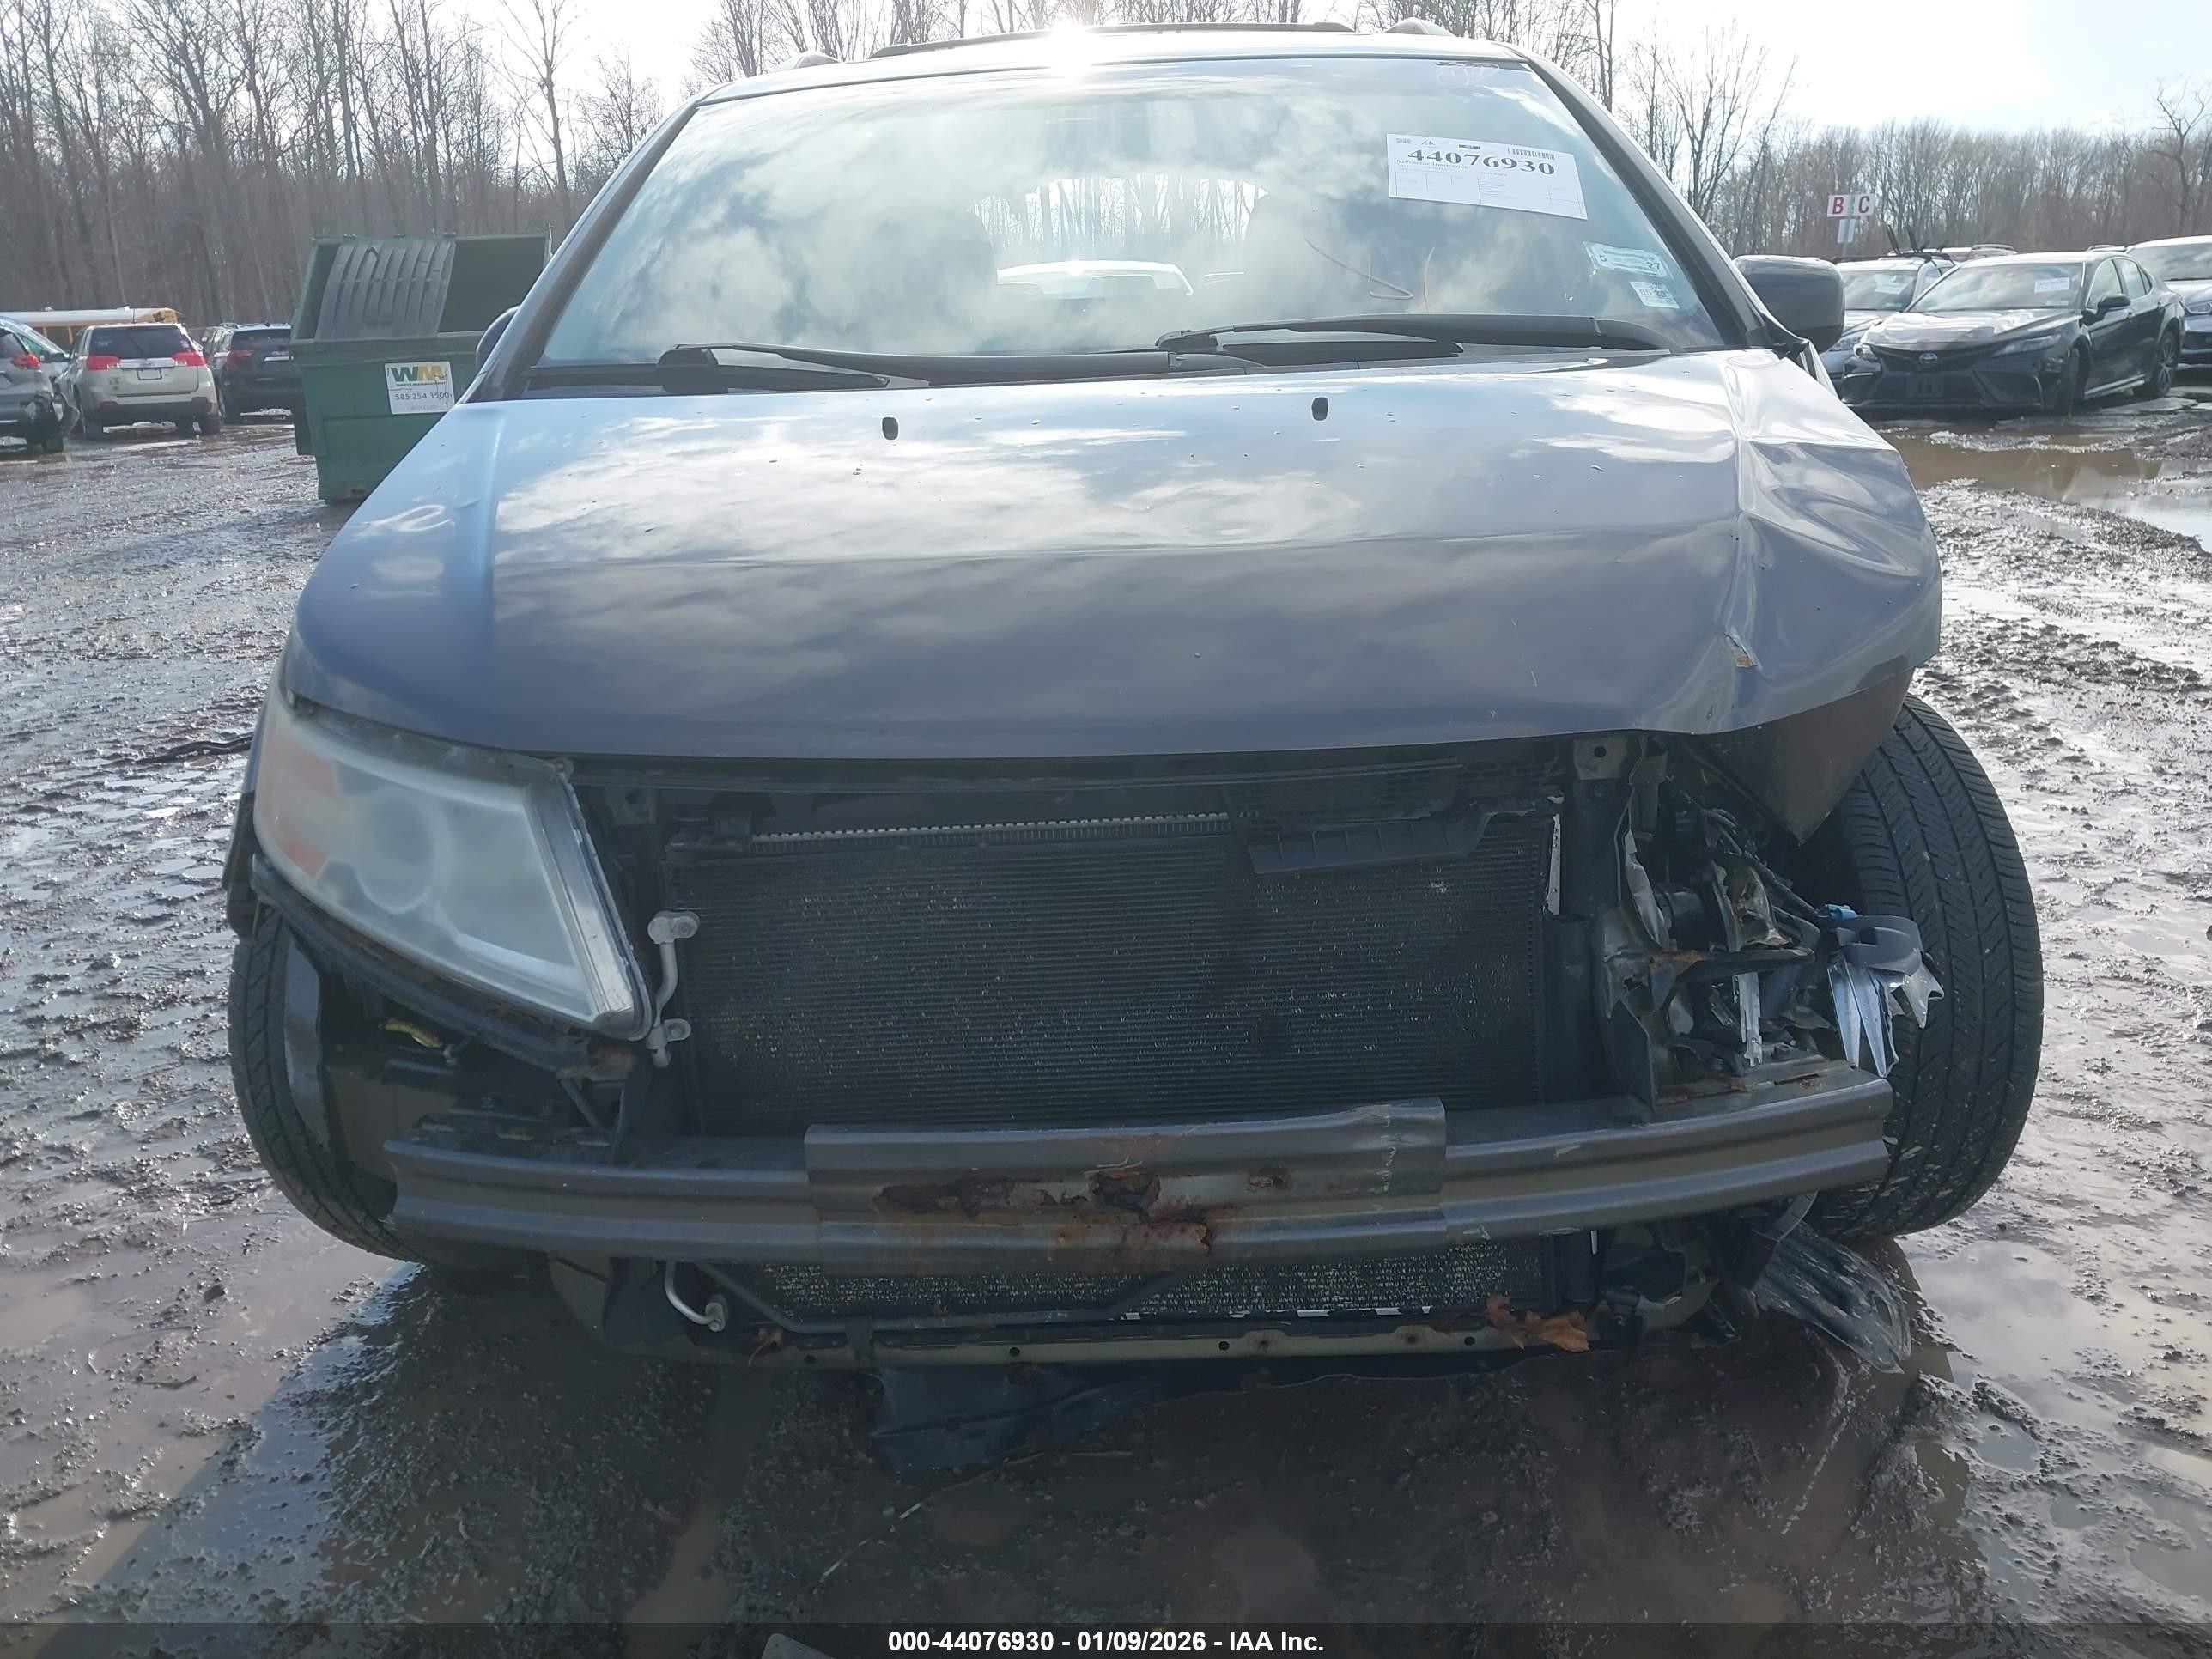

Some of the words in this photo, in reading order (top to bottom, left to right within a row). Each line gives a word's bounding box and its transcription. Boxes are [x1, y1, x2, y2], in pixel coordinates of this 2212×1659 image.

[1407, 149, 1555, 175] 44076930
[1832, 197, 1844, 215] B
[1858, 196, 1870, 214] C
[390, 366, 442, 382] WM
